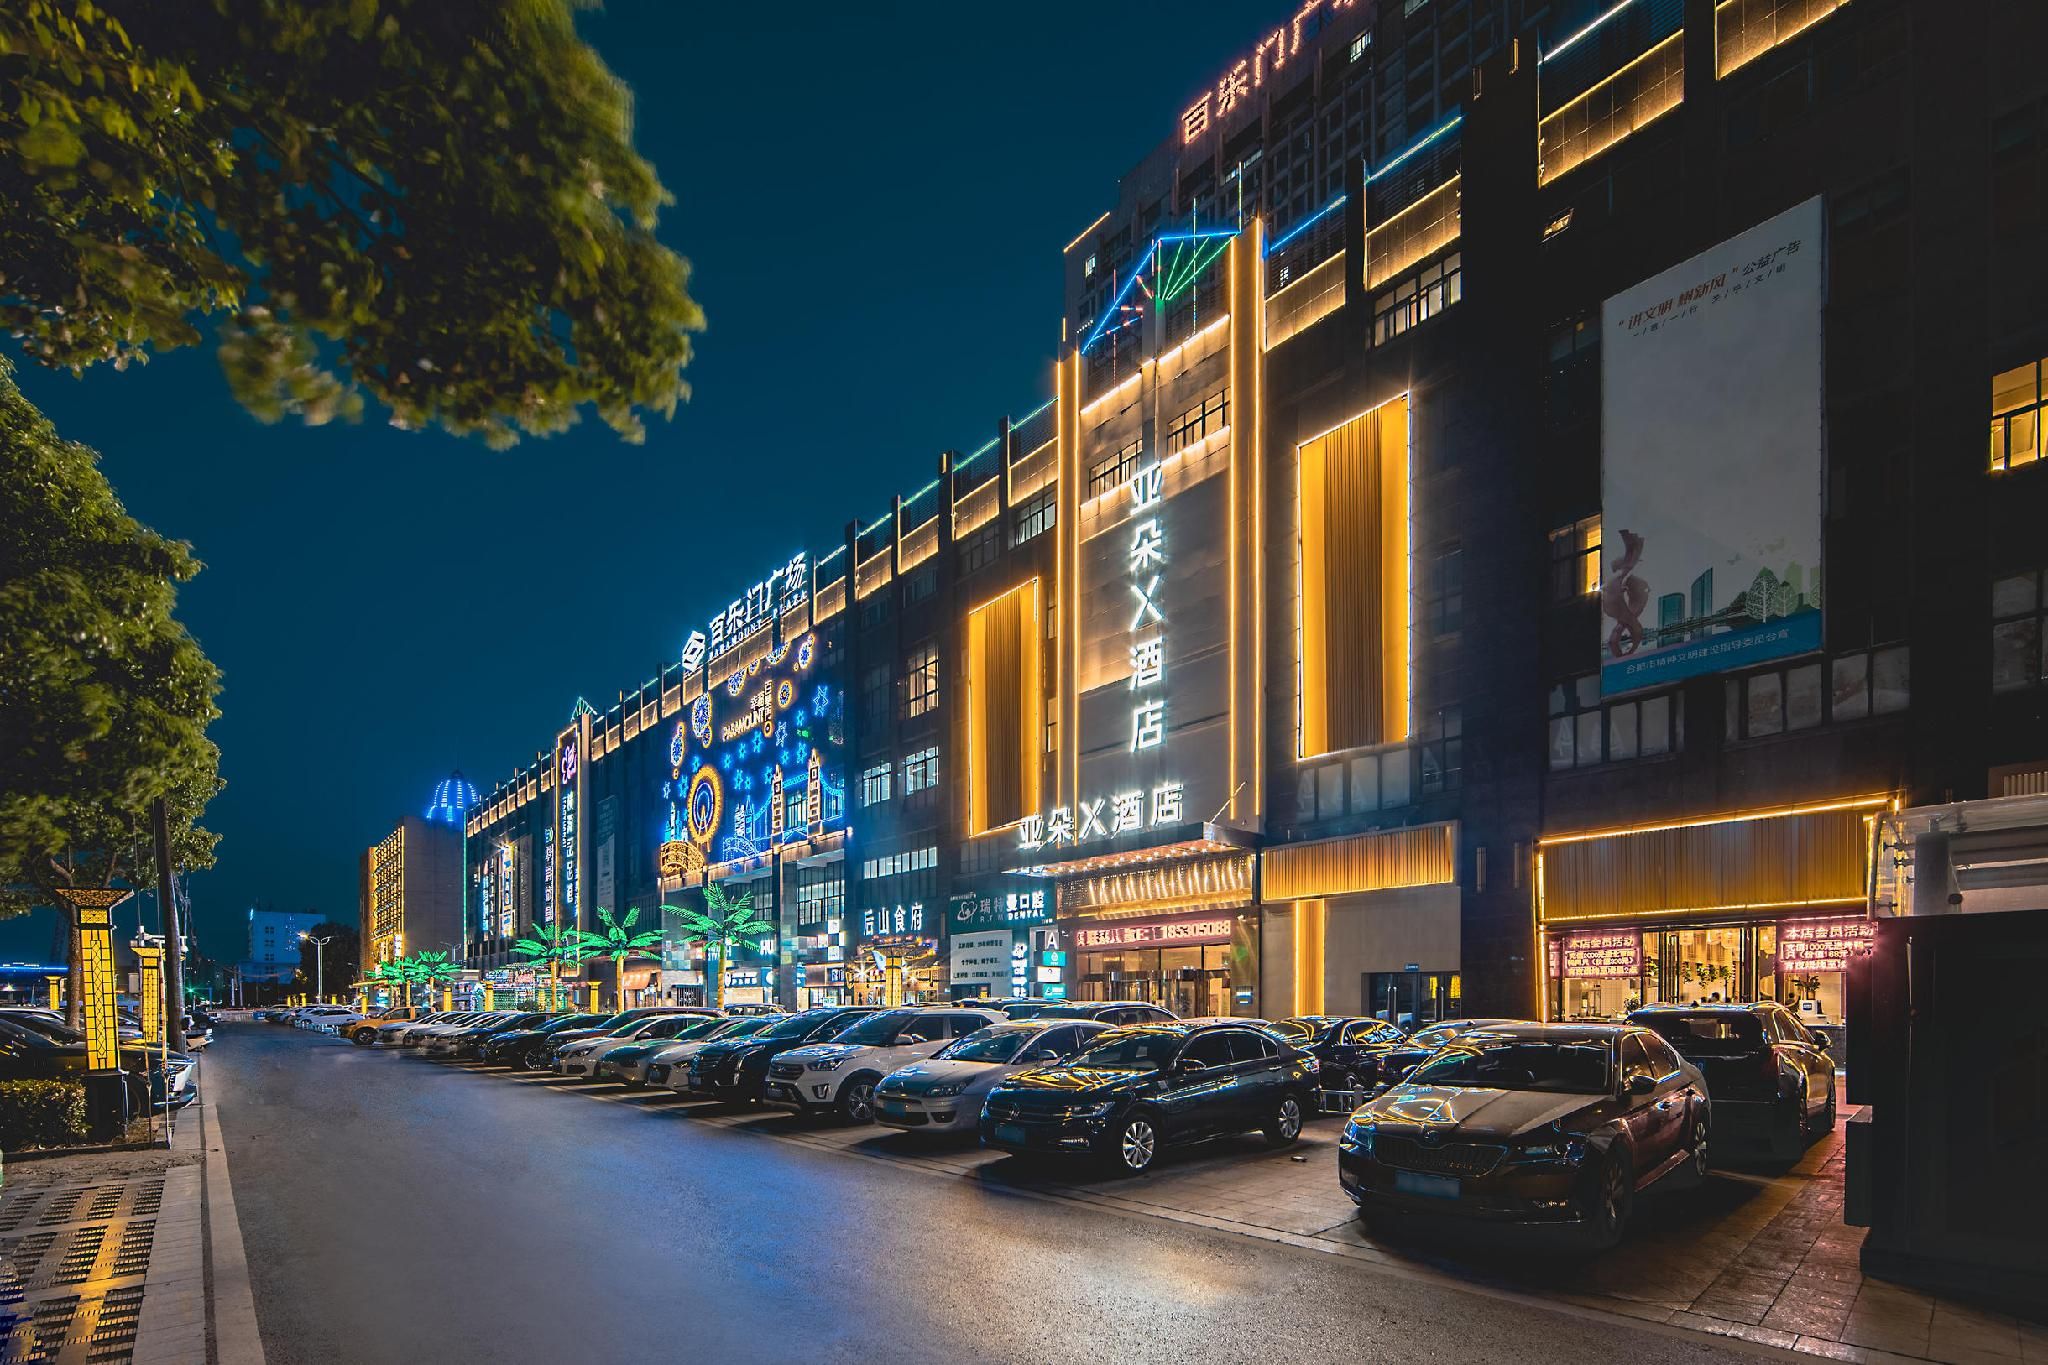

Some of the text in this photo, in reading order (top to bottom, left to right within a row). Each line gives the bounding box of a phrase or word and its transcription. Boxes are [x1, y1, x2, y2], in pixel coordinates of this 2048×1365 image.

[1181, 0, 1358, 144] 百乐门广
[1130, 463, 1164, 752] 亚朵X酒店
[1018, 783, 1184, 850] 亚朵X酒店
[1008, 909, 1046, 920] DENTAL
[1786, 925, 1873, 939] 本店会员活动
[1046, 932, 1059, 950] A
